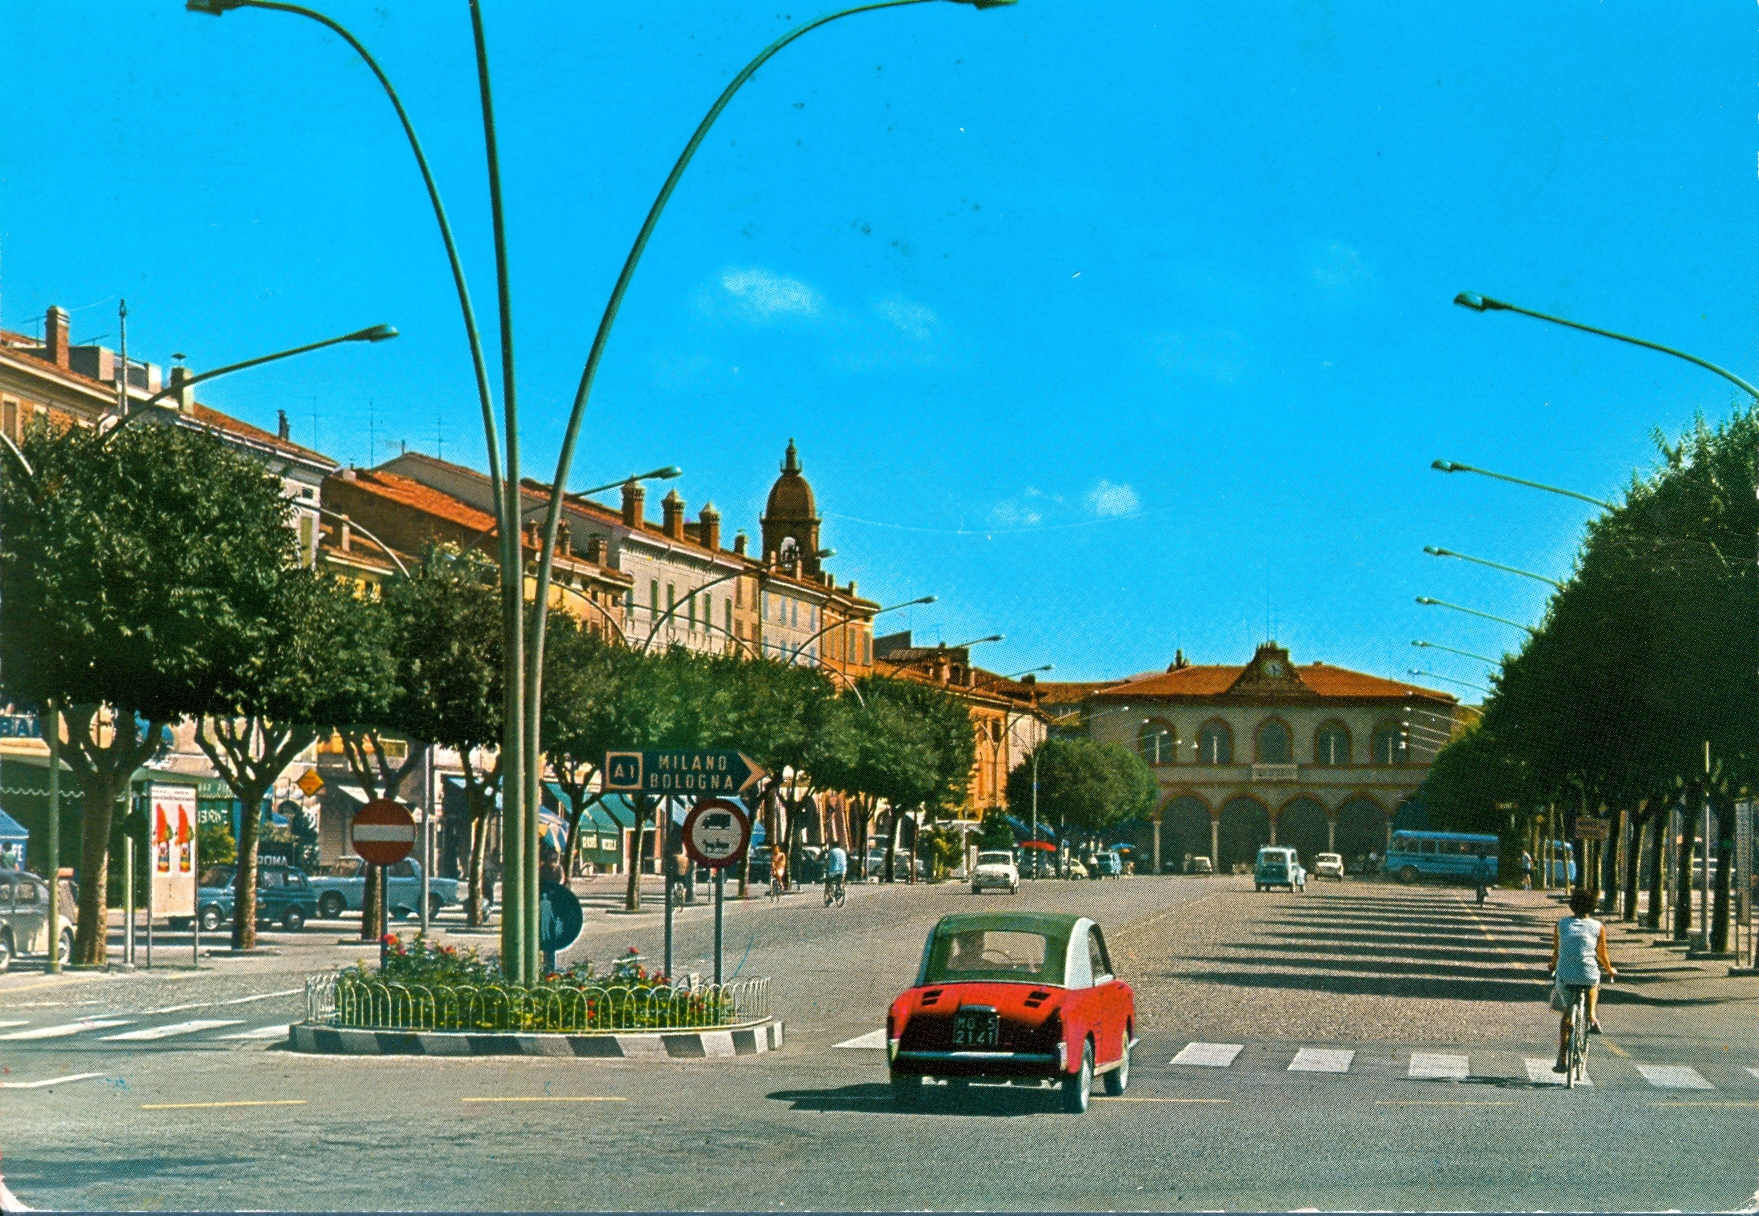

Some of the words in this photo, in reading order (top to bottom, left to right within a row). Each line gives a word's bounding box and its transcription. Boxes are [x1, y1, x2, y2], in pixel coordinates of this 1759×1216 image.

[658, 755, 727, 771] MILANO
[650, 773, 734, 790] BOLOGNA
[955, 1031, 993, 1044] 2141
